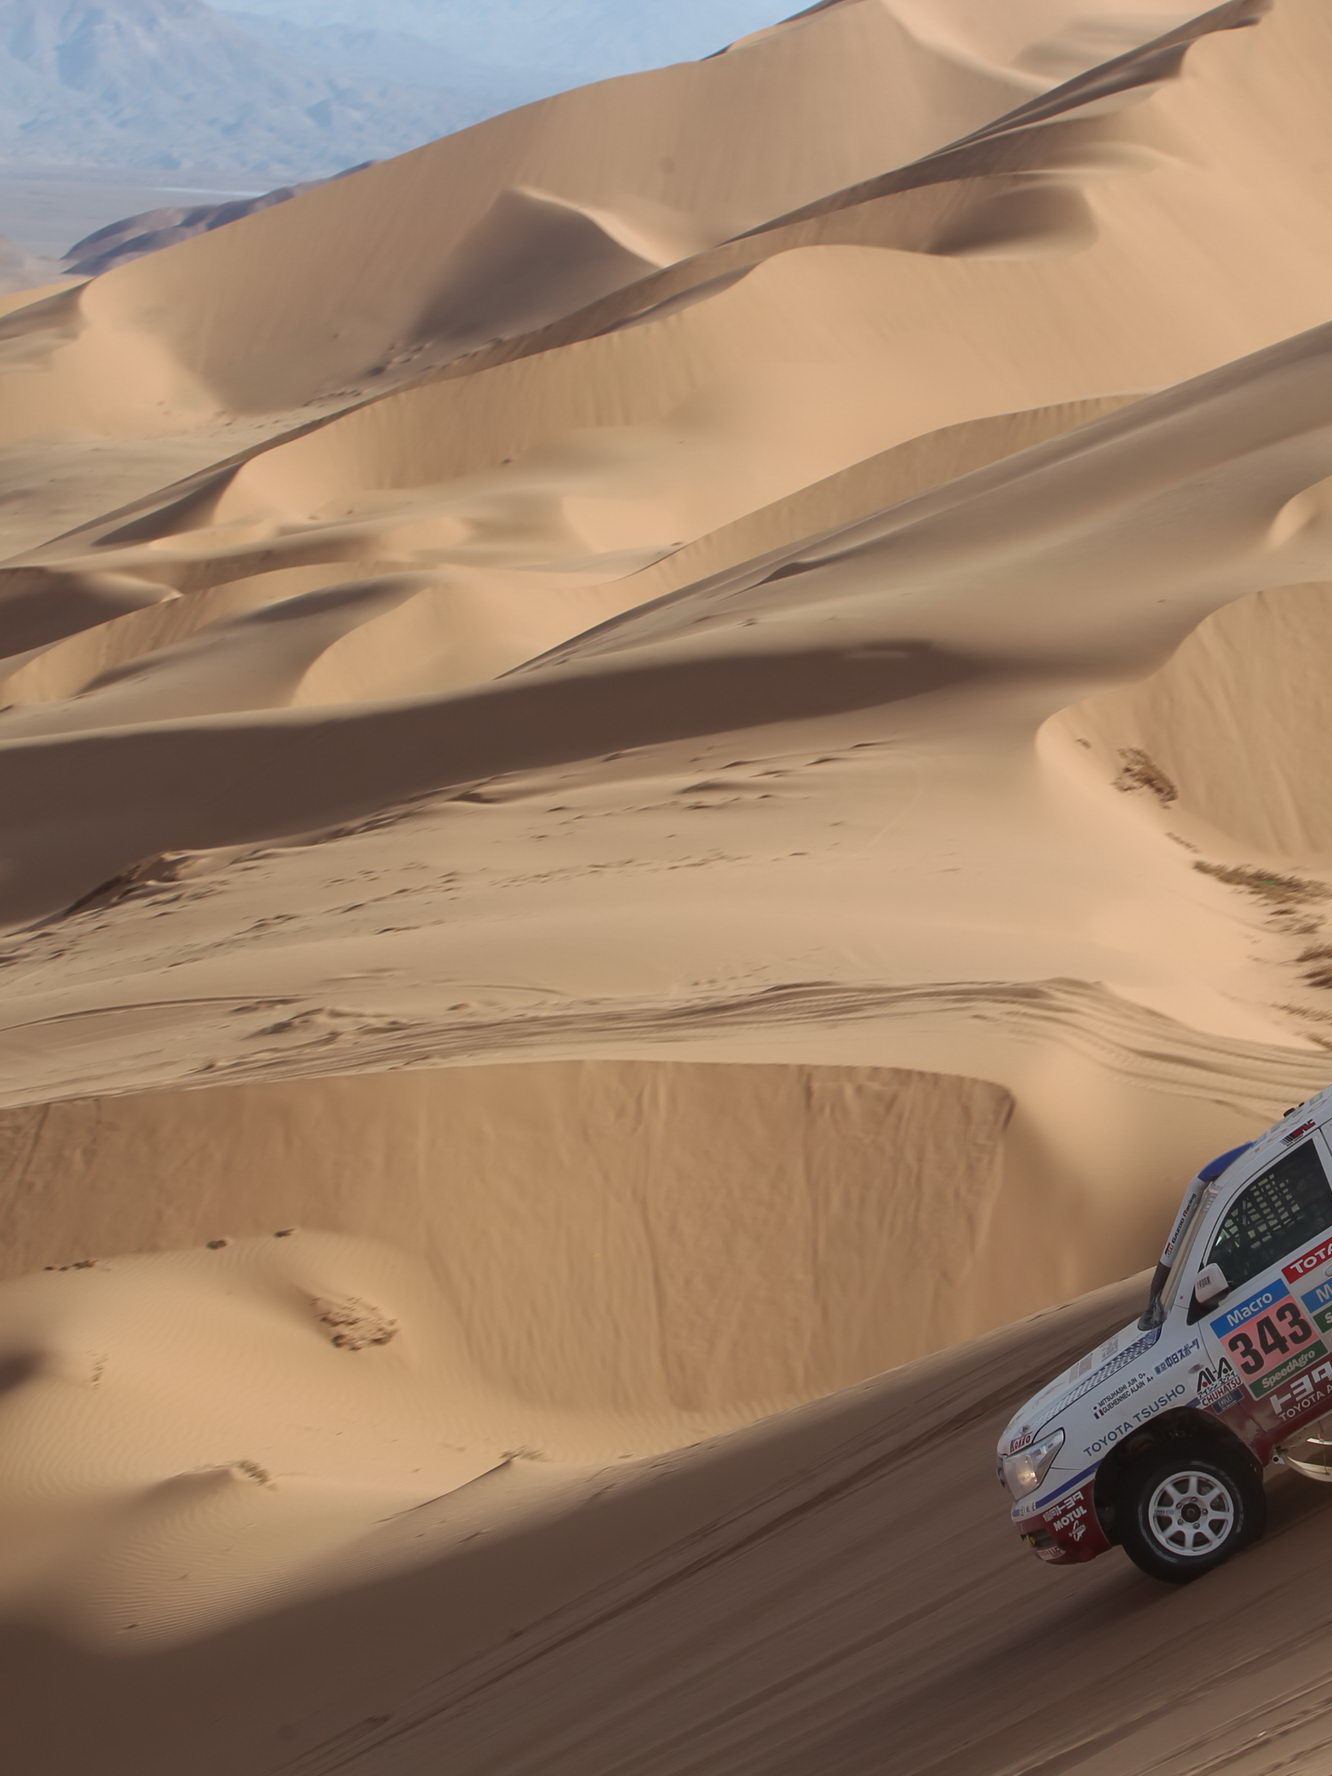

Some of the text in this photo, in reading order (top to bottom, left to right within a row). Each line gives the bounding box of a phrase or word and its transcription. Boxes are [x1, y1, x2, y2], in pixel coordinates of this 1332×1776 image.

[1225, 1291, 1274, 1326] Macro
[1225, 1299, 1314, 1377] 343
[1260, 1348, 1316, 1389] SpeedAgro
[1097, 1383, 1127, 1407] MITSUHASHI
[1126, 1377, 1138, 1387] JUN
[1101, 1390, 1131, 1413] GUEHENNEC
[1129, 1380, 1145, 1394] ALAIN
[1200, 1376, 1242, 1406] CHUHATSU
[1277, 1389, 1325, 1423] TOYOTA
[1083, 1420, 1132, 1458] TOYOTA
[1132, 1382, 1186, 1424] TSUSHO
[1052, 1504, 1087, 1531] MOTUL
